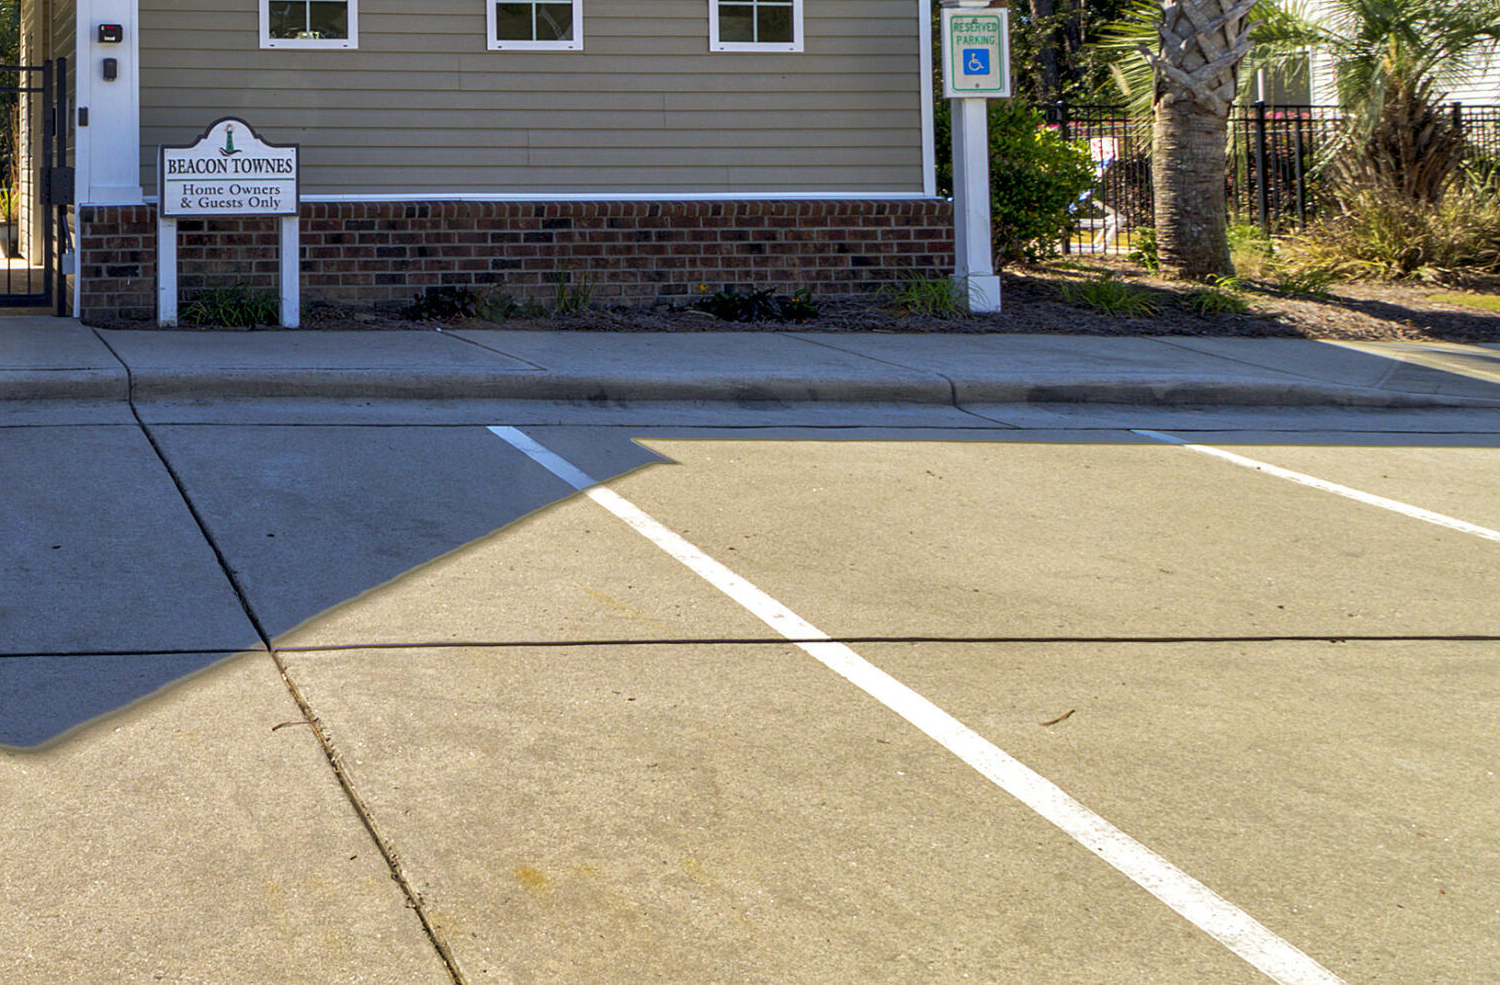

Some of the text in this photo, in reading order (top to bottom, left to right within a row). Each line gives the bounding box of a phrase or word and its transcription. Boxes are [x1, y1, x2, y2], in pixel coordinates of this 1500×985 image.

[953, 22, 998, 33] RESERVED
[956, 35, 996, 46] PARKING
[167, 158, 293, 175] BEACON TOWNES
[182, 184, 281, 195] Home Owners
[180, 196, 281, 211] & Guests Only
